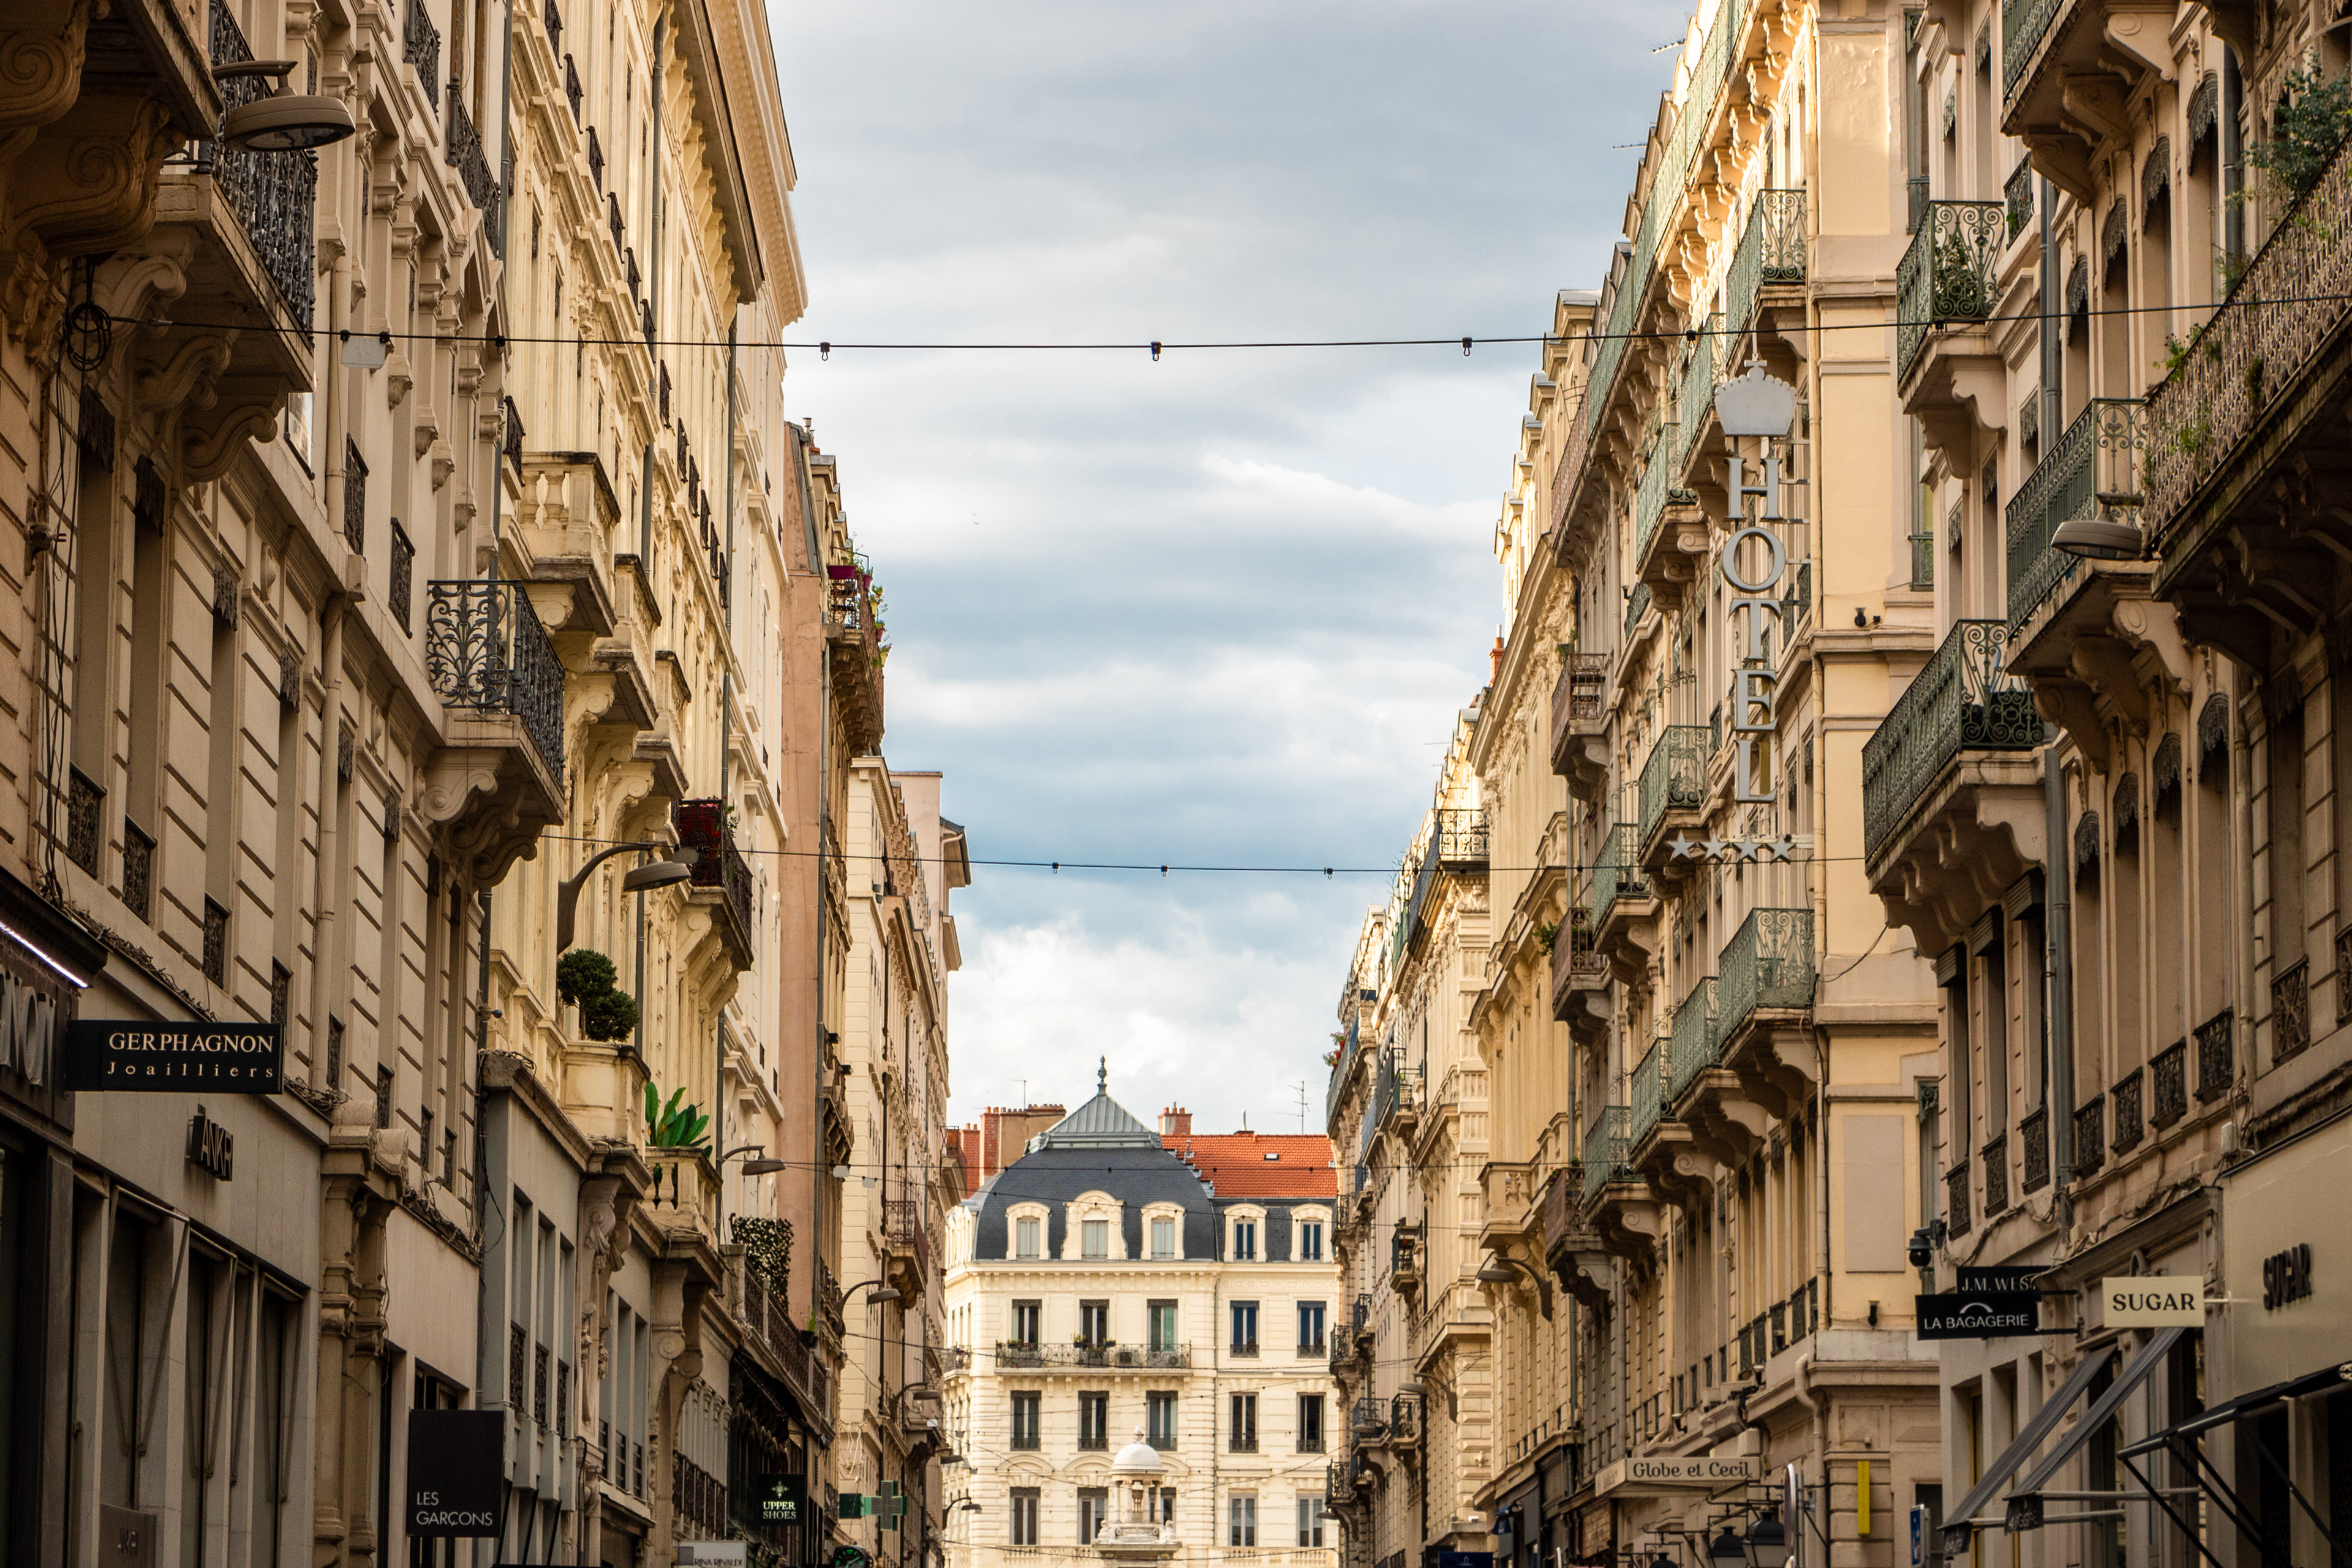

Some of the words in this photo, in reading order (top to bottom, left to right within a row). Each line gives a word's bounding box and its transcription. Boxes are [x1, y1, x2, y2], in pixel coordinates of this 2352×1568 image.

[1721, 458, 1786, 802] HOTEL
[0, 964, 56, 1095] NON
[109, 1033, 274, 1053] GERPHAGNON
[107, 1061, 273, 1077] Joailliers
[1962, 1277, 1991, 1291] J.M.
[1994, 1277, 2037, 1291] WES
[2113, 1293, 2195, 1311] SUGAR
[1924, 1317, 1942, 1330] LA
[1946, 1314, 2029, 1329] BAGAGERIE
[1633, 1462, 1682, 1478] Globe
[1687, 1463, 1705, 1477] et
[1709, 1461, 1751, 1477] Cecil
[417, 1491, 439, 1506] LES
[763, 1501, 796, 1510] UPPER
[417, 1511, 493, 1527] GARÇONS
[763, 1510, 797, 1519] SHOES
